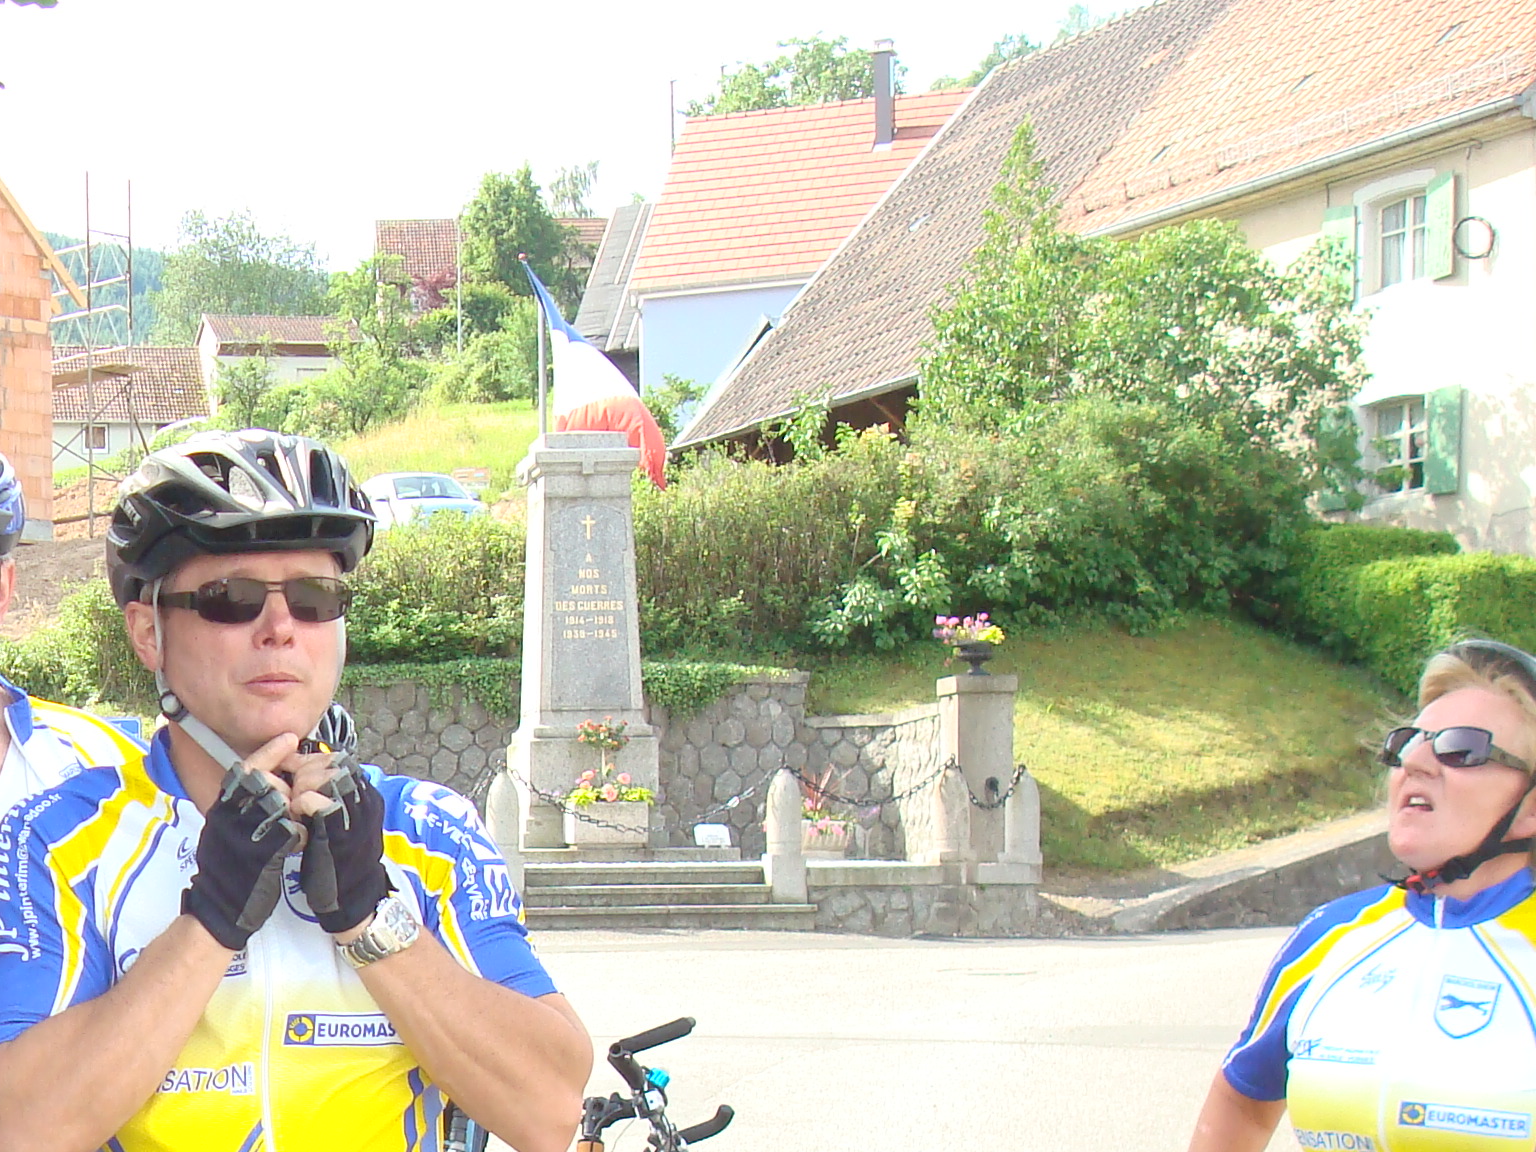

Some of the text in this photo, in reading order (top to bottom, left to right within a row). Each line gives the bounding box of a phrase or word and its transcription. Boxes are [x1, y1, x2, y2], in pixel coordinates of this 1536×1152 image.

[585, 552, 593, 563] A
[578, 569, 600, 579] NOS
[571, 585, 608, 595] MORTS
[555, 600, 624, 611] DES GUERRES
[317, 1022, 396, 1038] EUROMAS
[1427, 1110, 1527, 1131] EUROMASTER
